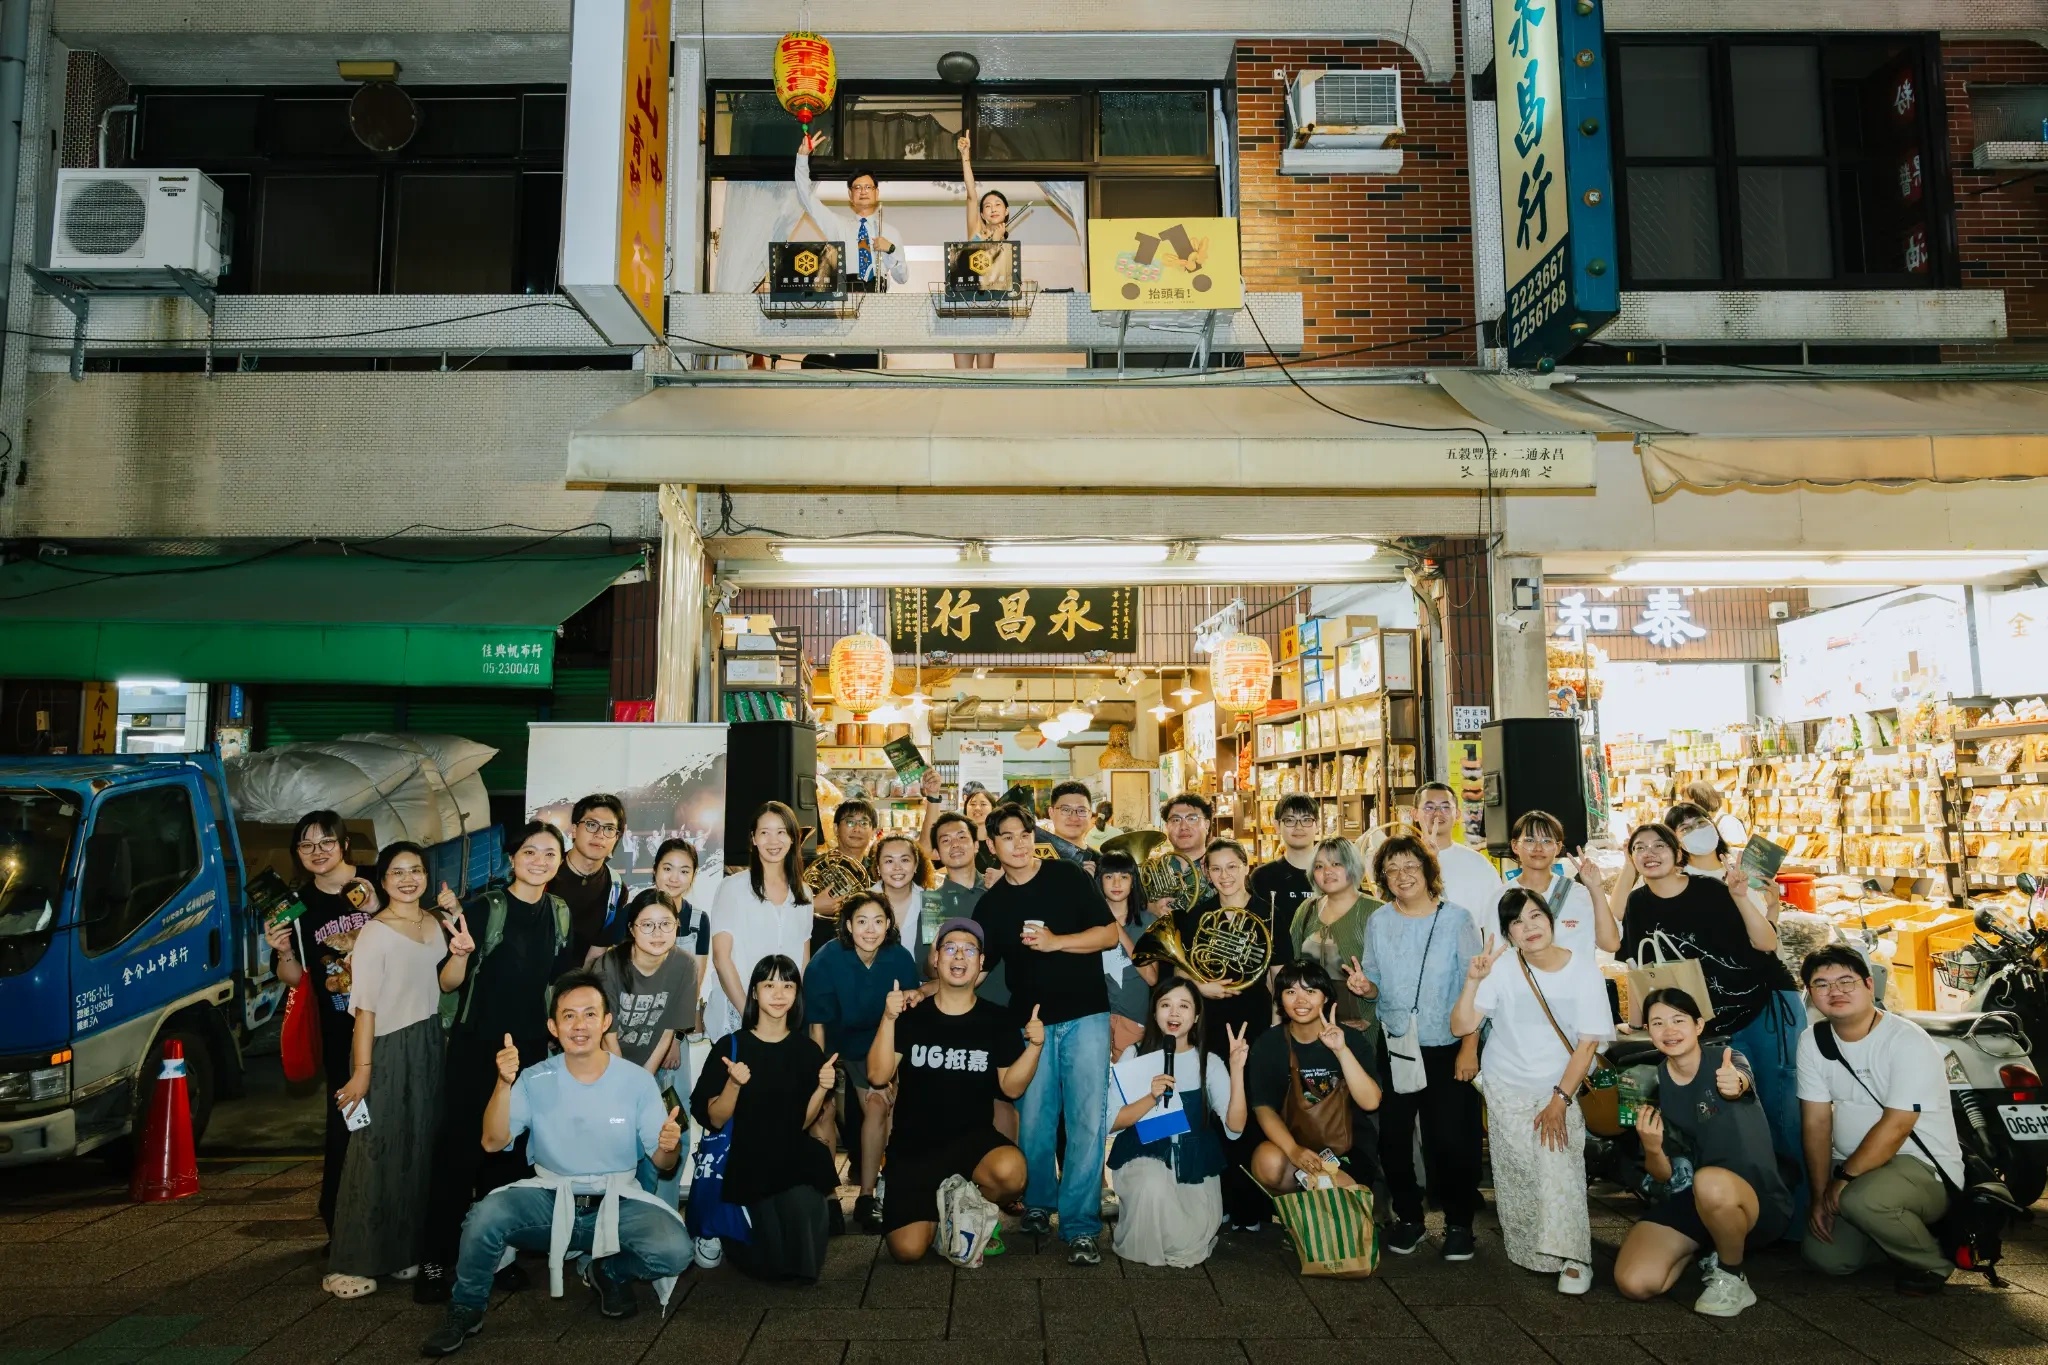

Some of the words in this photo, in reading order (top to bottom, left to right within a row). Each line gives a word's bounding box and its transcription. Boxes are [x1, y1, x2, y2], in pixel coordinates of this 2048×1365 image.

[1508, 0, 1552, 250] 永昌行
[1511, 246, 1565, 319] 2223667
[1513, 279, 1567, 349] 2256788
[932, 589, 1104, 642] 永昌行
[482, 644, 543, 658] 佳典帆布行
[482, 663, 540, 675] 05-2300478
[2006, 1116, 2048, 1134] 066-H
